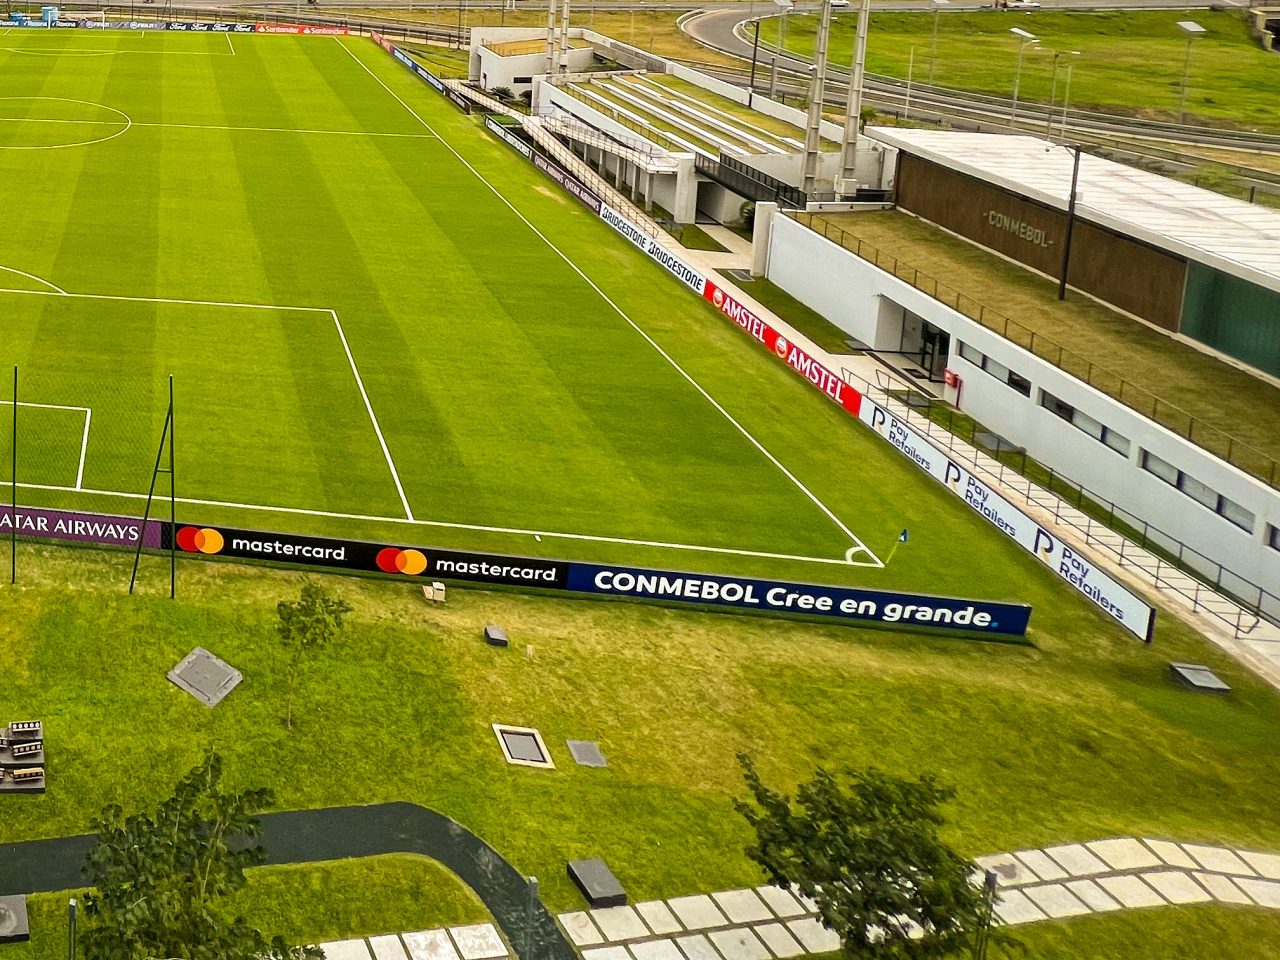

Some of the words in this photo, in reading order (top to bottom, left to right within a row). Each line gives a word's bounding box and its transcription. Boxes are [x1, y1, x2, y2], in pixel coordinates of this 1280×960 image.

[191, 23, 208, 31] Ford
[233, 24, 250, 32] Ford
[265, 25, 299, 34] Santander
[310, 27, 345, 35] Santander
[602, 206, 647, 248] BRIDGESTONE
[648, 241, 704, 291] BRIDGESTONE
[722, 296, 766, 344] AMSTEL
[787, 347, 844, 404] AMSTEL
[890, 418, 909, 442] Pay
[888, 430, 931, 471] Retailers
[967, 476, 990, 502] Pay
[964, 490, 1017, 537] Retailers
[53, 518, 139, 541] AIRWAYS
[232, 536, 346, 562] mastercard
[1061, 547, 1091, 578] Pay
[436, 556, 557, 583] mastercard
[594, 570, 759, 605] CONMEBOL
[766, 587, 834, 611] Cree
[839, 596, 876, 616] en
[1059, 562, 1125, 620] Retailers
